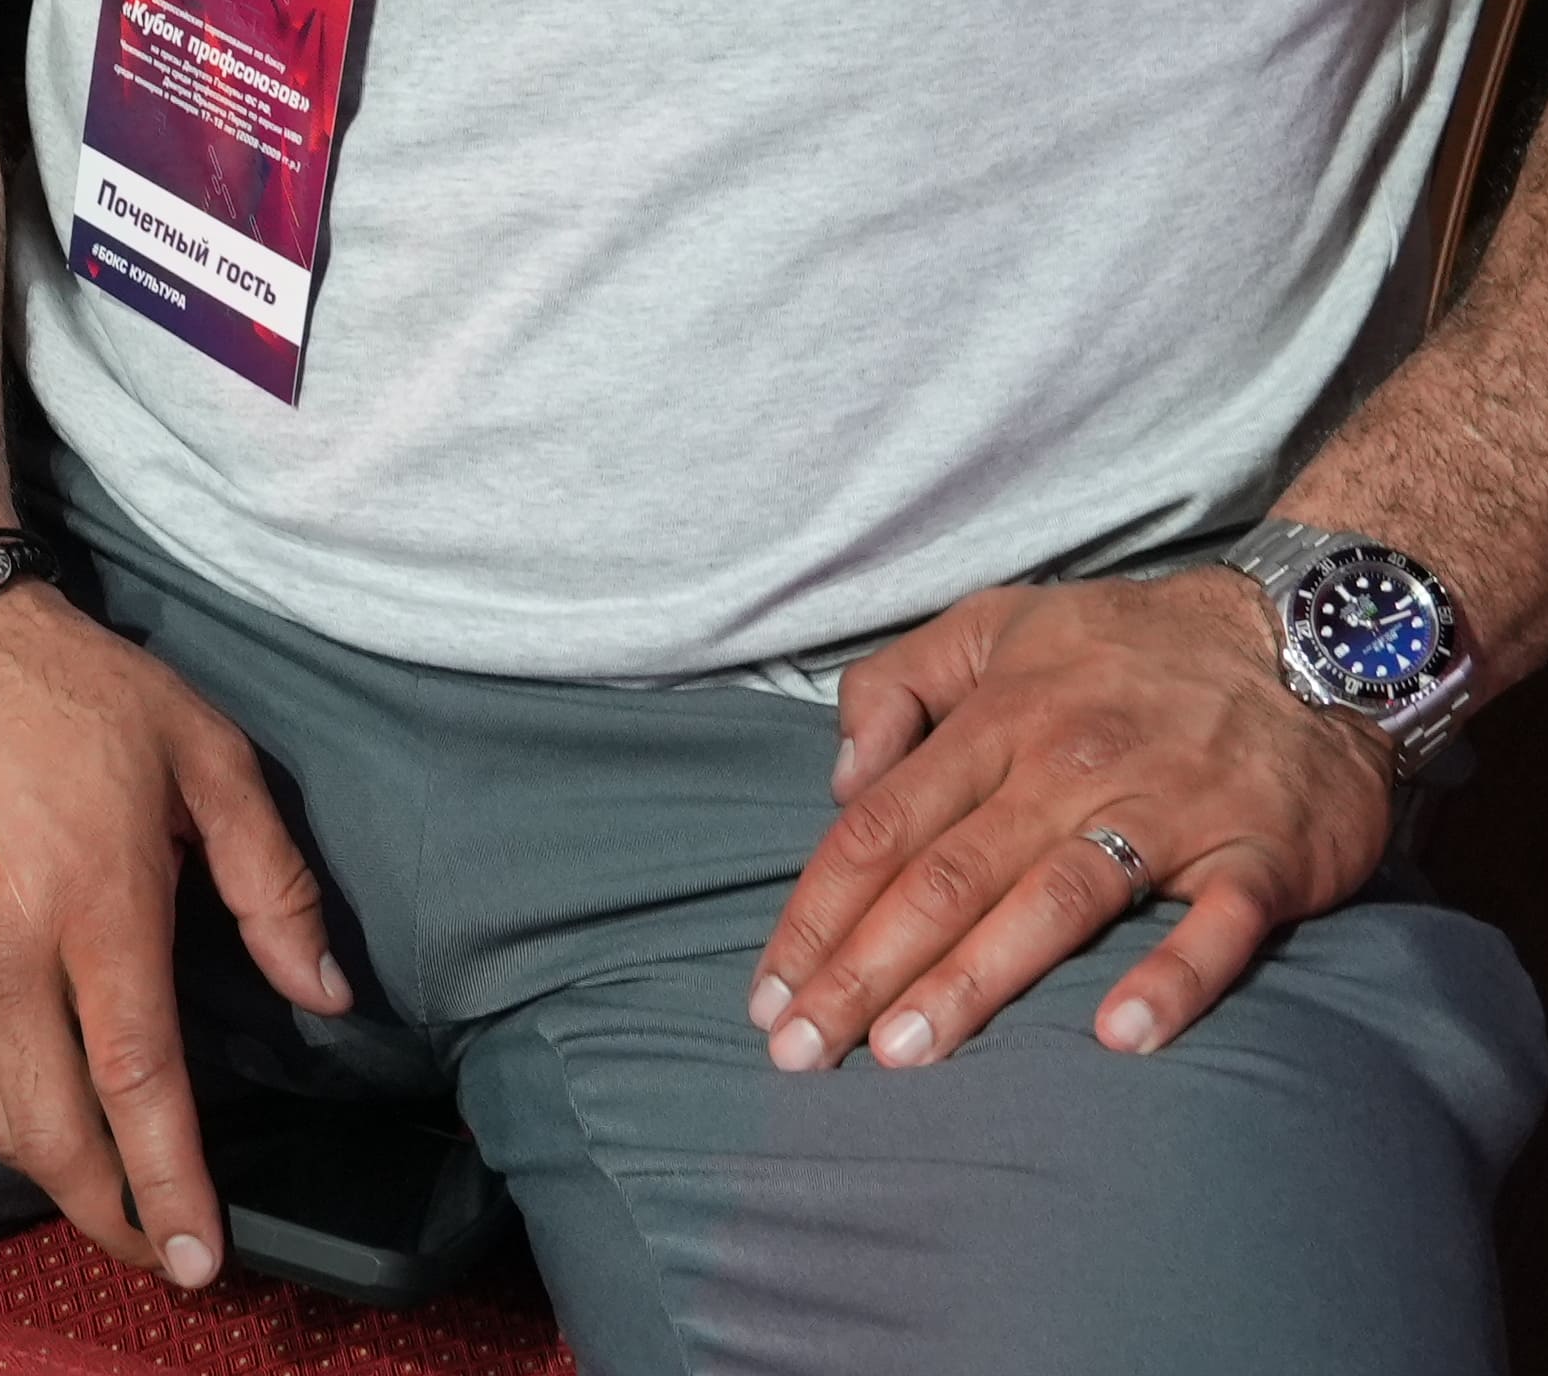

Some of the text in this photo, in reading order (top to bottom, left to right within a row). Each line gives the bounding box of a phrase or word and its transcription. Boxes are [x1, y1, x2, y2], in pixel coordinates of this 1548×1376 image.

[122, 0, 309, 111] «Кубок профсоюзов»
[92, 243, 185, 309] #БОКС КУЛЬТУРА
[97, 179, 275, 304] Почетный гость
